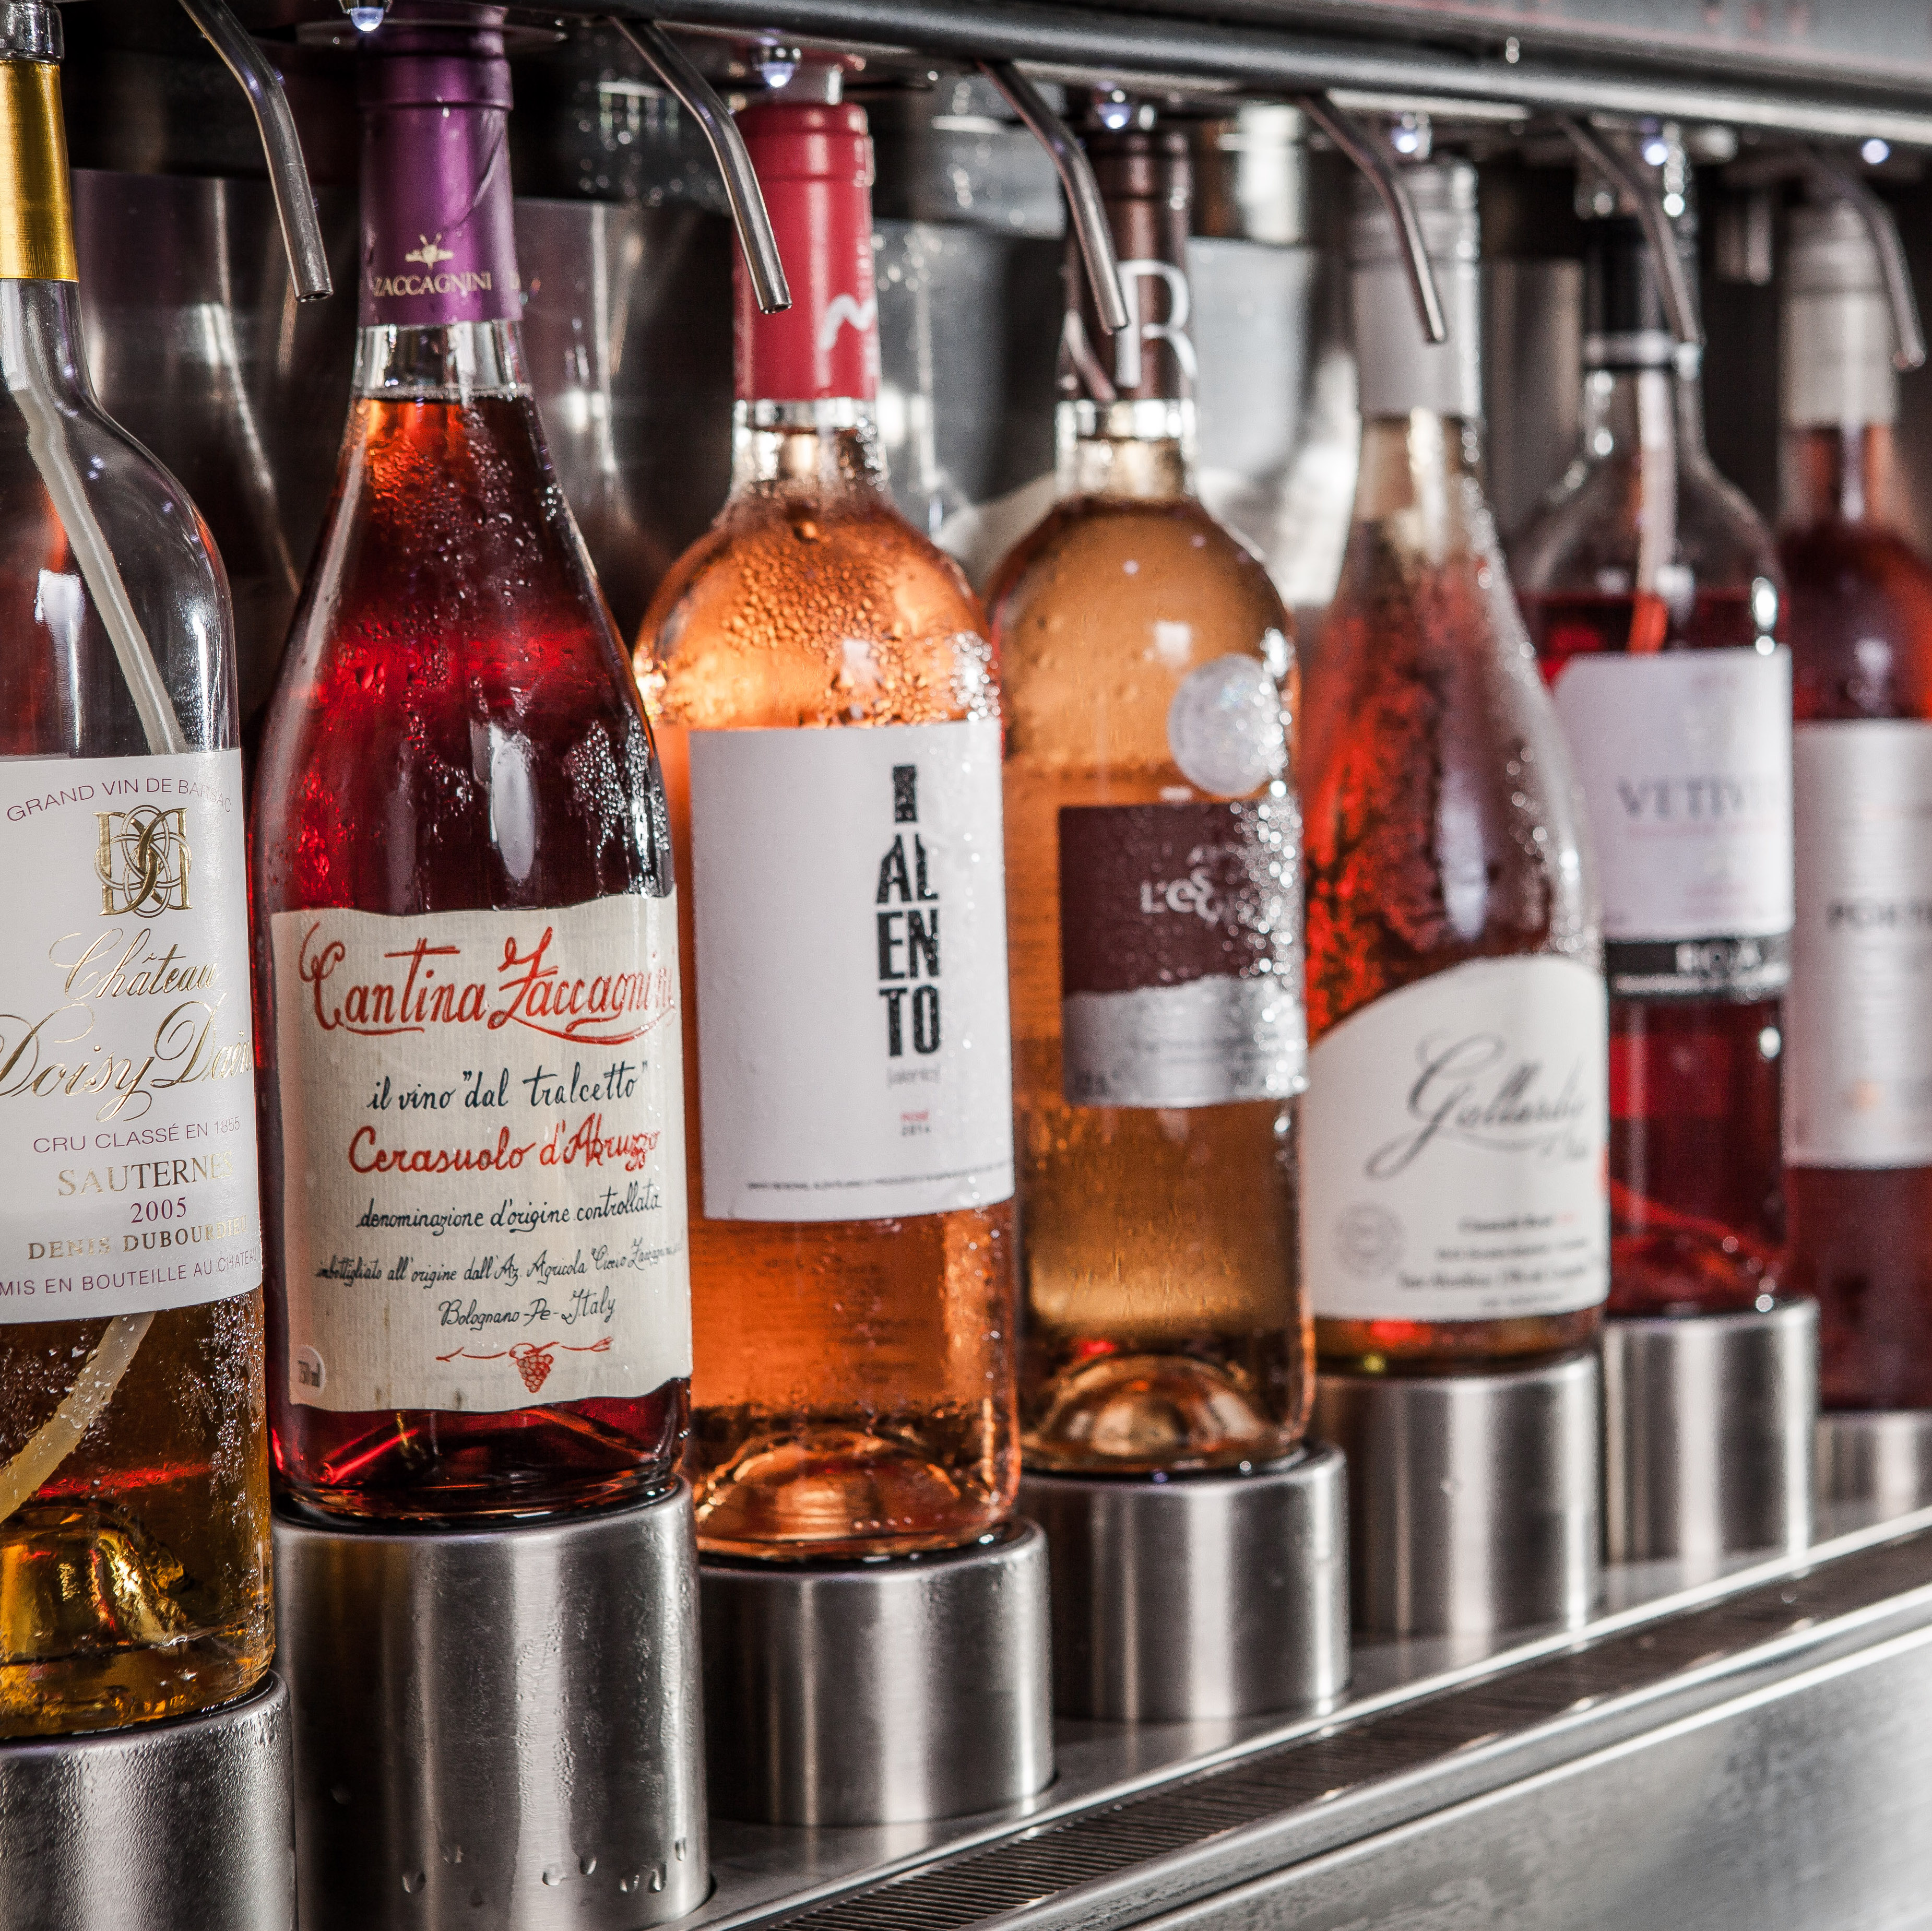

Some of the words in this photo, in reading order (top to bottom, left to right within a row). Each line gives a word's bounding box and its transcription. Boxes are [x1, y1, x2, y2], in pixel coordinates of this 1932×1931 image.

[7, 785, 94, 822] GRAND
[102, 778, 139, 796] VIN
[146, 778, 172, 793] DE
[178, 779, 231, 812] BARSAC
[49, 928, 218, 999] Château
[299, 921, 487, 1035] Cantina
[366, 1075, 392, 1110] il
[398, 1083, 457, 1110] vino
[33, 1135, 86, 1153] CRU
[95, 1122, 180, 1148] CLASSÉ
[186, 1122, 207, 1139] EN
[214, 1116, 241, 1134] 1855
[348, 1126, 536, 1174] Cerasuolo
[57, 1150, 233, 1196] SAUTERNES
[130, 1196, 186, 1224] 2005
[355, 1198, 484, 1237] denominazione
[490, 1199, 571, 1233] d'origine
[576, 1178, 663, 1222] controllata
[28, 1237, 111, 1260] DENIS
[122, 1215, 247, 1253] DUBOURDIEU
[0, 1280, 35, 1297] MIS
[45, 1277, 72, 1294] EN
[82, 1264, 187, 1291] BOUTEILLE
[193, 1259, 212, 1277] AU
[526, 1249, 589, 1285] Agricola
